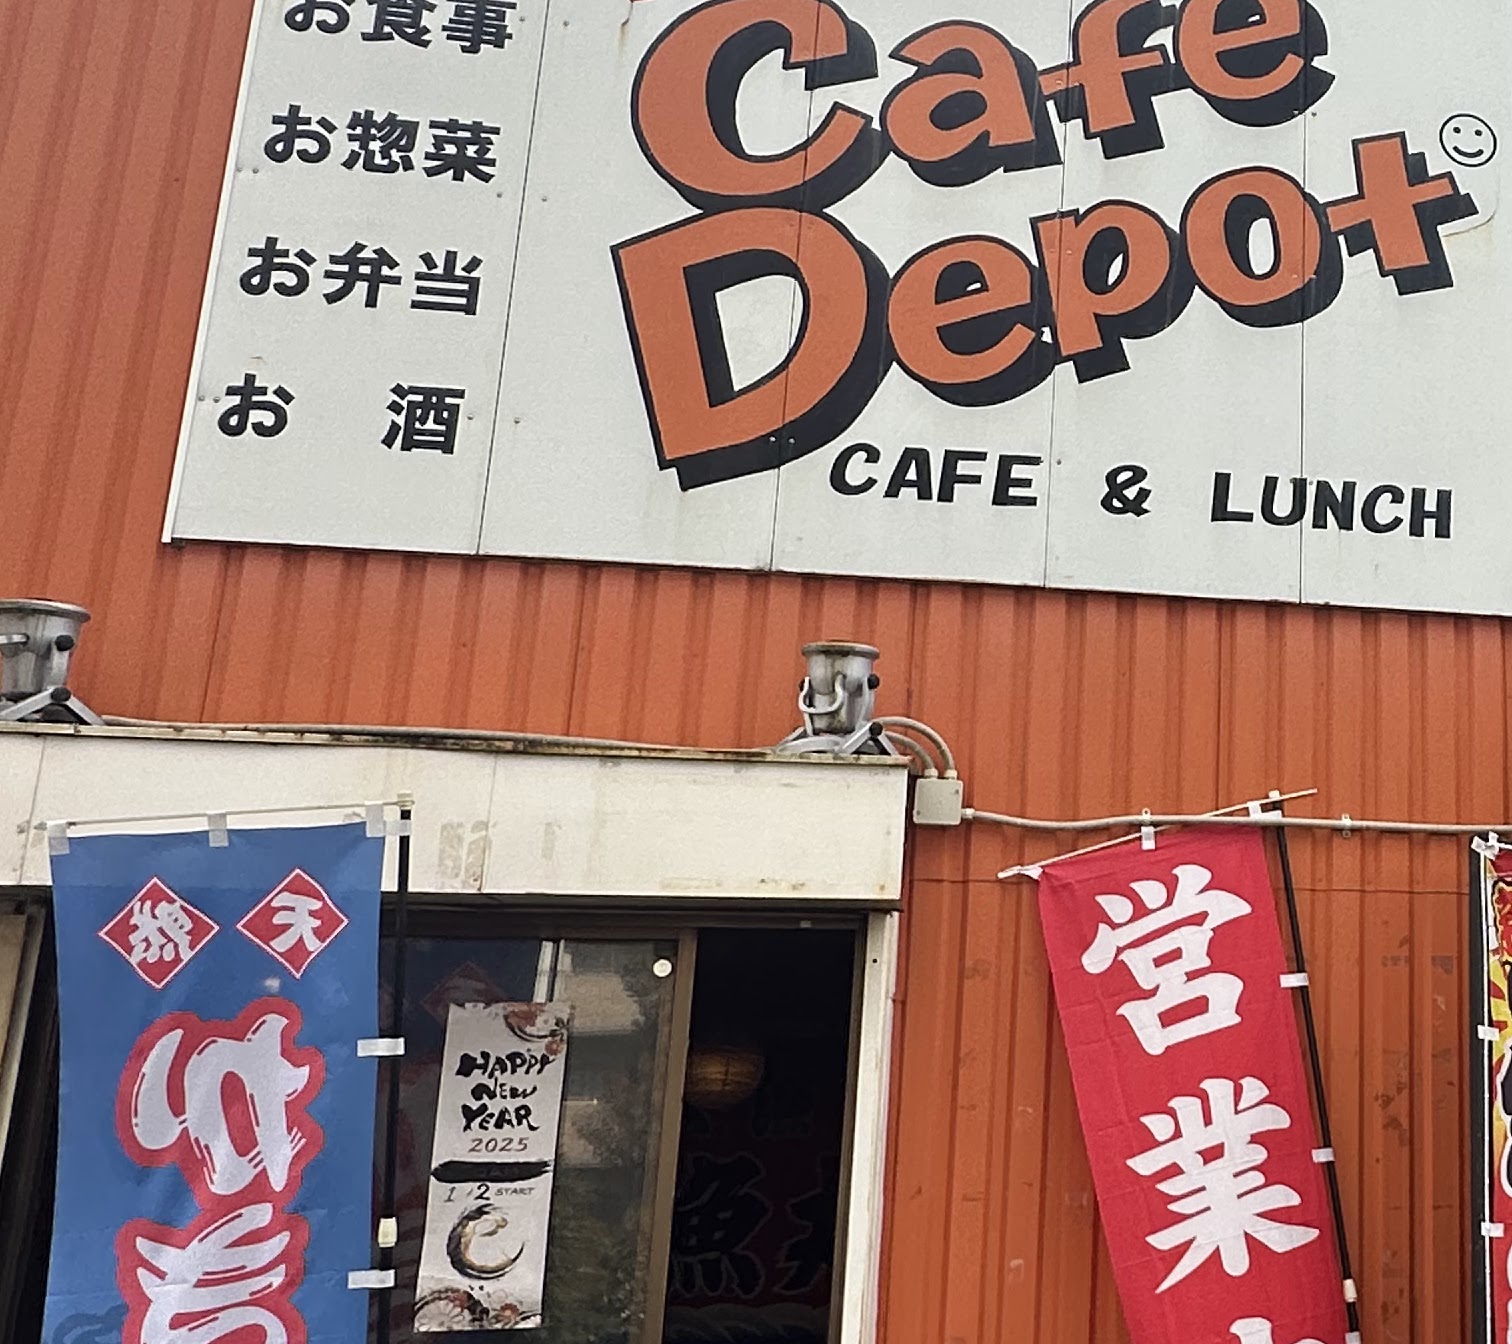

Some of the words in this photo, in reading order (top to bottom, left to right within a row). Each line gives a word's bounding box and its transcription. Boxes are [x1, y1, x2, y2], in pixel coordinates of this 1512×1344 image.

[263, 104, 501, 183] お惣菜
[239, 236, 483, 316] お弁当
[610, 132, 1478, 491] Depot
[829, 441, 1042, 509] CAFE
[1102, 464, 1153, 516] &
[1210, 472, 1454, 539] LUNCH
[456, 1051, 555, 1079] HAPPY
[461, 1103, 540, 1132] YEAR
[468, 1137, 530, 1153] 2025
[495, 1187, 535, 1197] START
